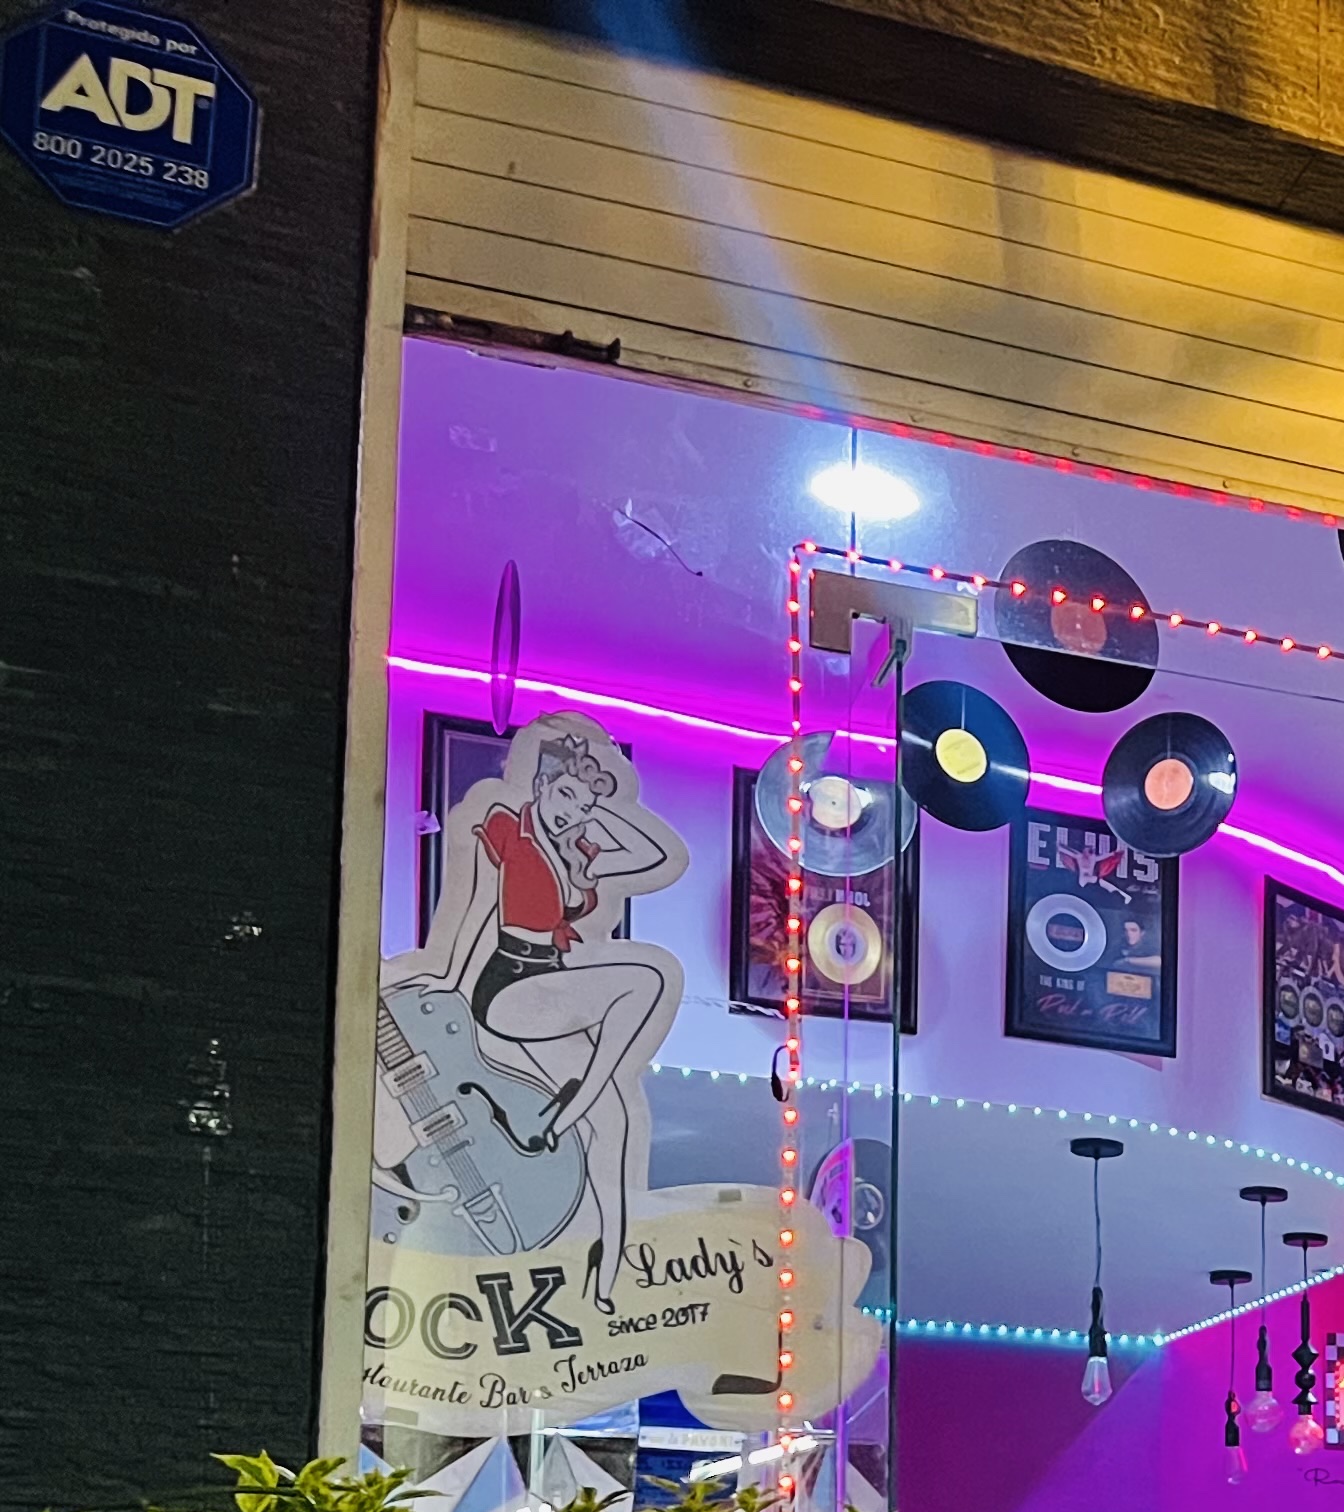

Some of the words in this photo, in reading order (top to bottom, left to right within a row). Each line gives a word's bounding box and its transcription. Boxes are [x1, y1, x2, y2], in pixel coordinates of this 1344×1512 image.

[65, 8, 160, 46] Protegido
[166, 39, 197, 55] por
[40, 52, 216, 145] ADT
[33, 131, 82, 160] 800
[90, 145, 154, 177] 2025
[162, 161, 209, 190] 238
[363, 1265, 584, 1361] OCK
[607, 1313, 658, 1338] since
[660, 1302, 711, 1330] 2017
[479, 1372, 530, 1409] Bar
[553, 1353, 648, 1393] Terraza
